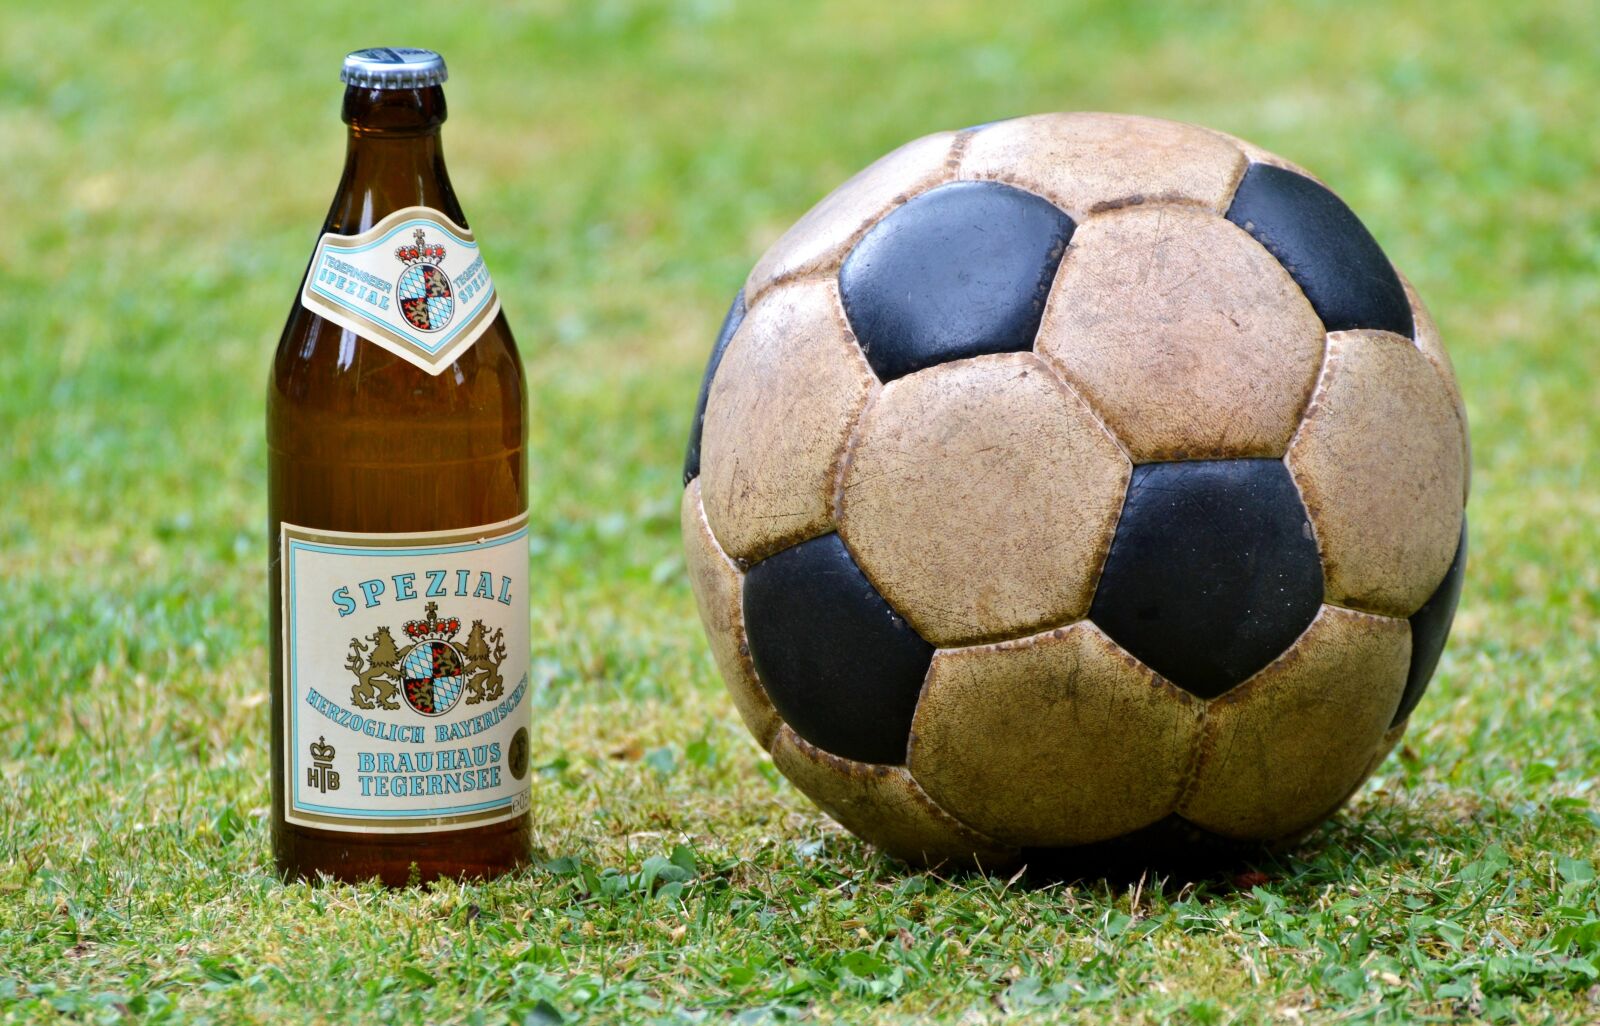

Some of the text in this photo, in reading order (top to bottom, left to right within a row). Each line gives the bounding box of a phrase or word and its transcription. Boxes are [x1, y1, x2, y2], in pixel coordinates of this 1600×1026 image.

[319, 268, 390, 311] SPEZIAL
[324, 254, 393, 294] TEGERNSEER
[331, 569, 513, 617] SPEZIAL
[305, 686, 426, 743] HERZOGLICH
[357, 742, 502, 774] BRAUHAUS
[358, 765, 502, 798] TEGERNSEE
